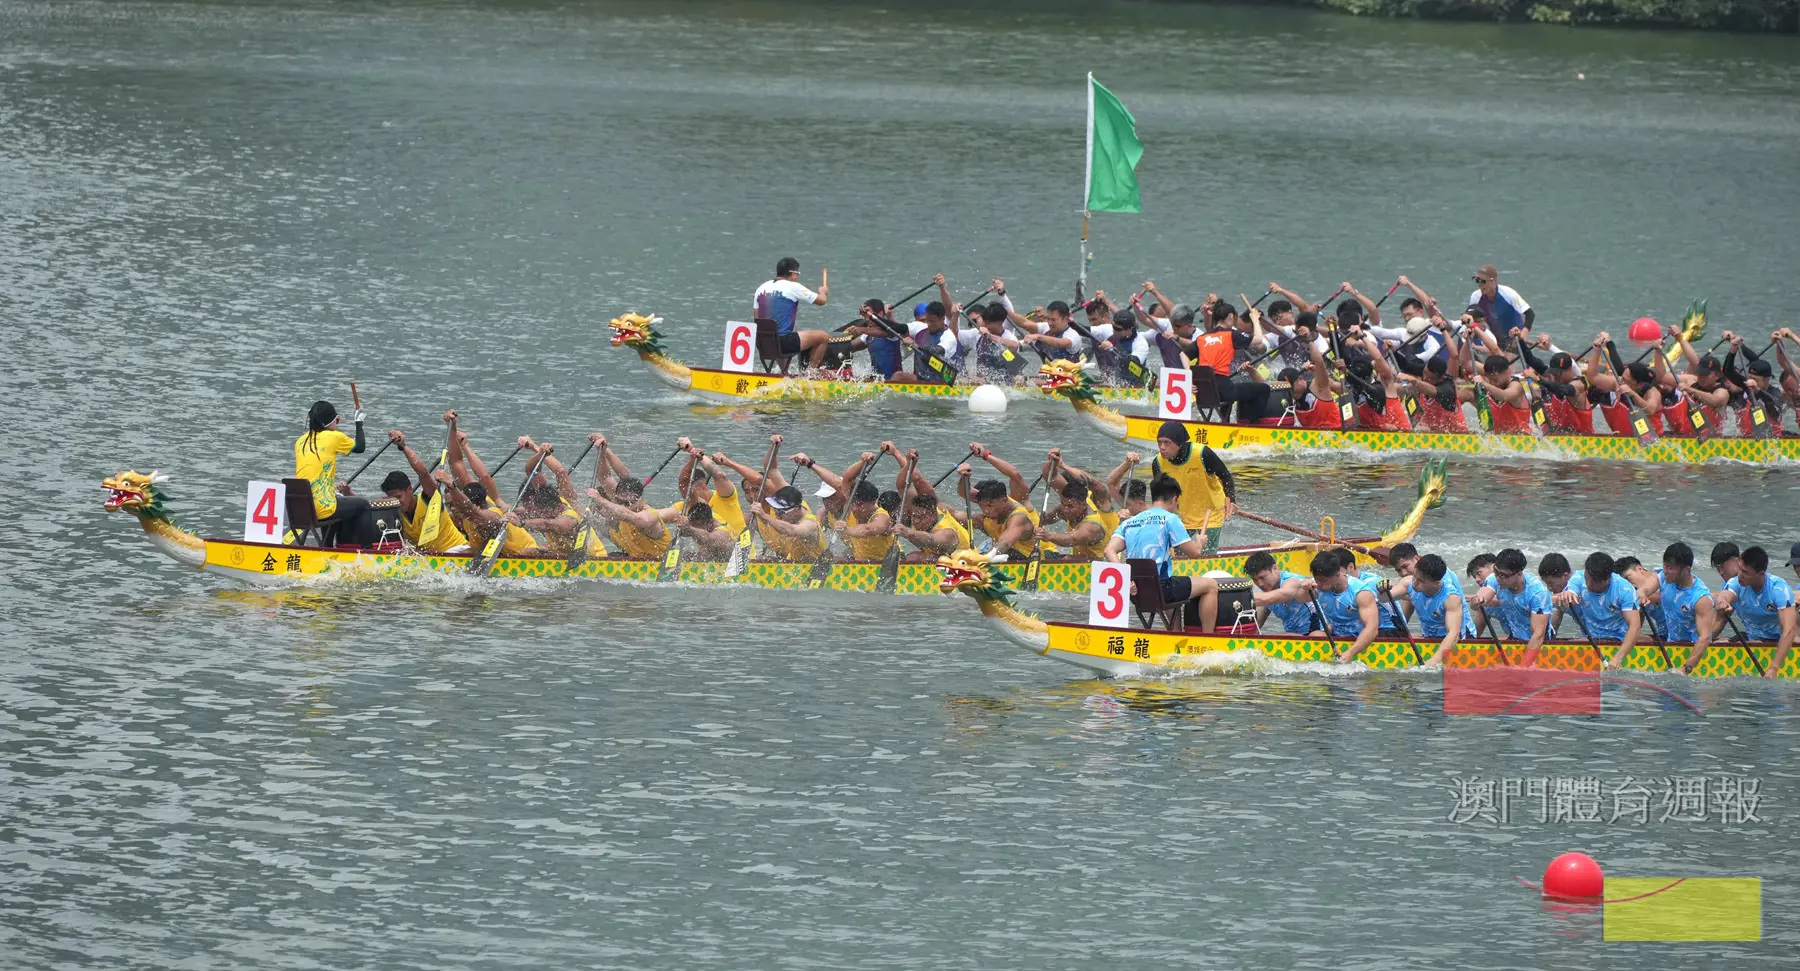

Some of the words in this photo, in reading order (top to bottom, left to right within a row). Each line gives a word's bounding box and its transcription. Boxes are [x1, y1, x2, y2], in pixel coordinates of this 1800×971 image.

[730, 326, 751, 365] 6
[1165, 373, 1187, 414] 5
[252, 488, 278, 535] 4
[261, 552, 302, 573] 金龍
[1097, 567, 1124, 619] 3
[1107, 636, 1150, 659] 福龍
